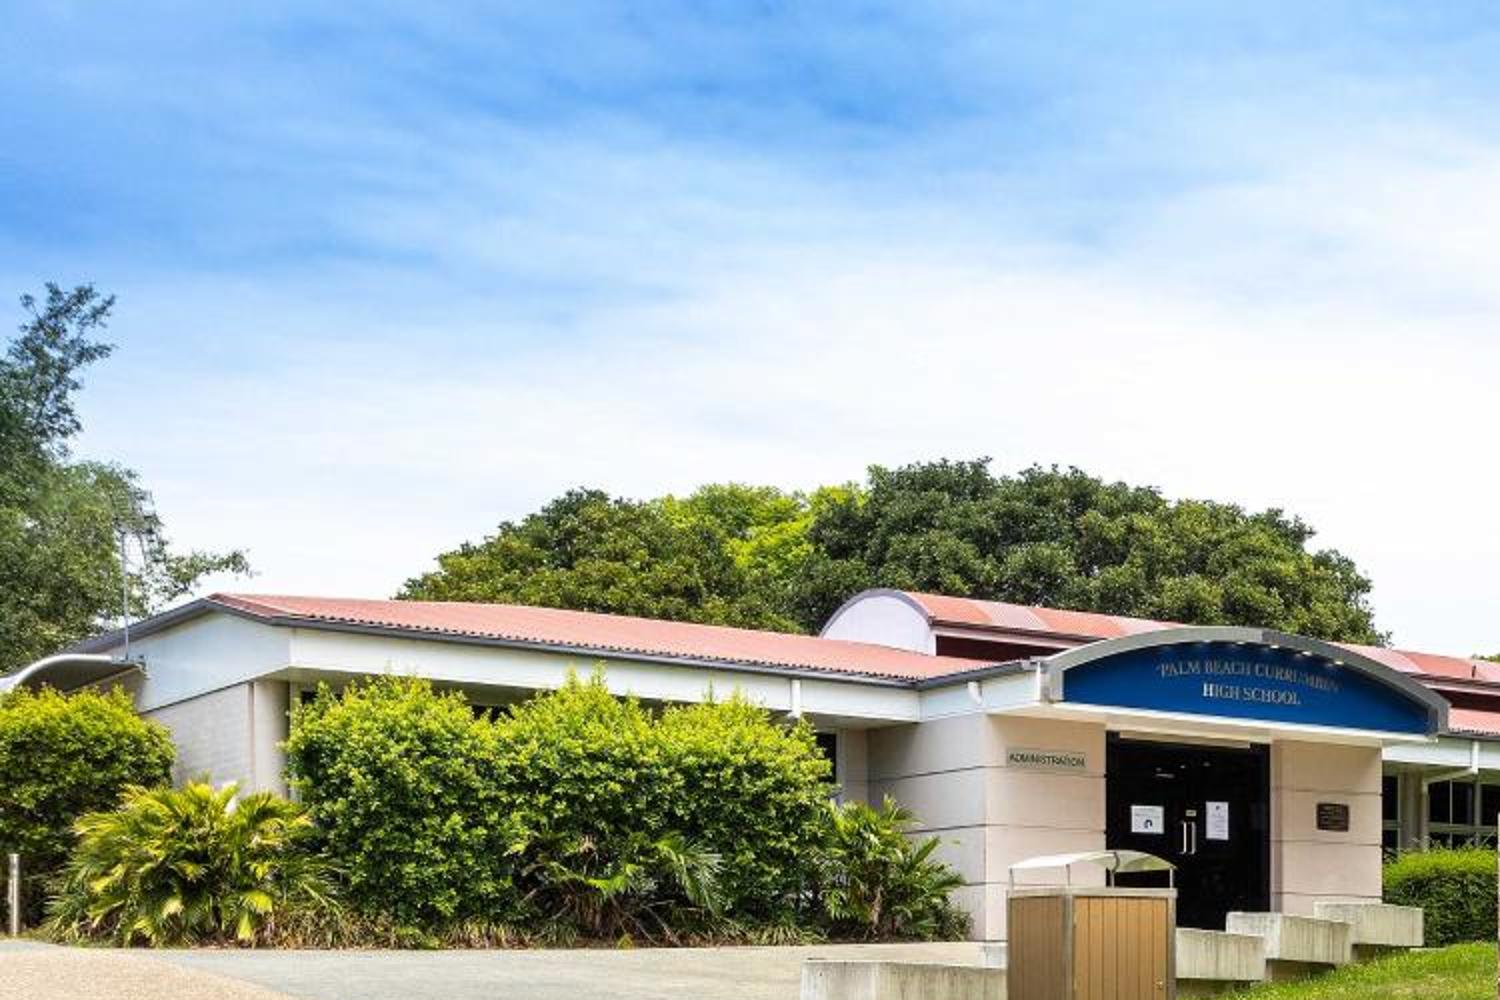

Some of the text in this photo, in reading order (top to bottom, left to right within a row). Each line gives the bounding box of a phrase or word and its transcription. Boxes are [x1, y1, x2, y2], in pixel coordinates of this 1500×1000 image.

[1158, 662, 1200, 678] PALM
[1205, 660, 1250, 675] BEACH
[1203, 683, 1300, 705] HIGH SCHOOL
[1009, 752, 1086, 767] ADMINISTRATION
